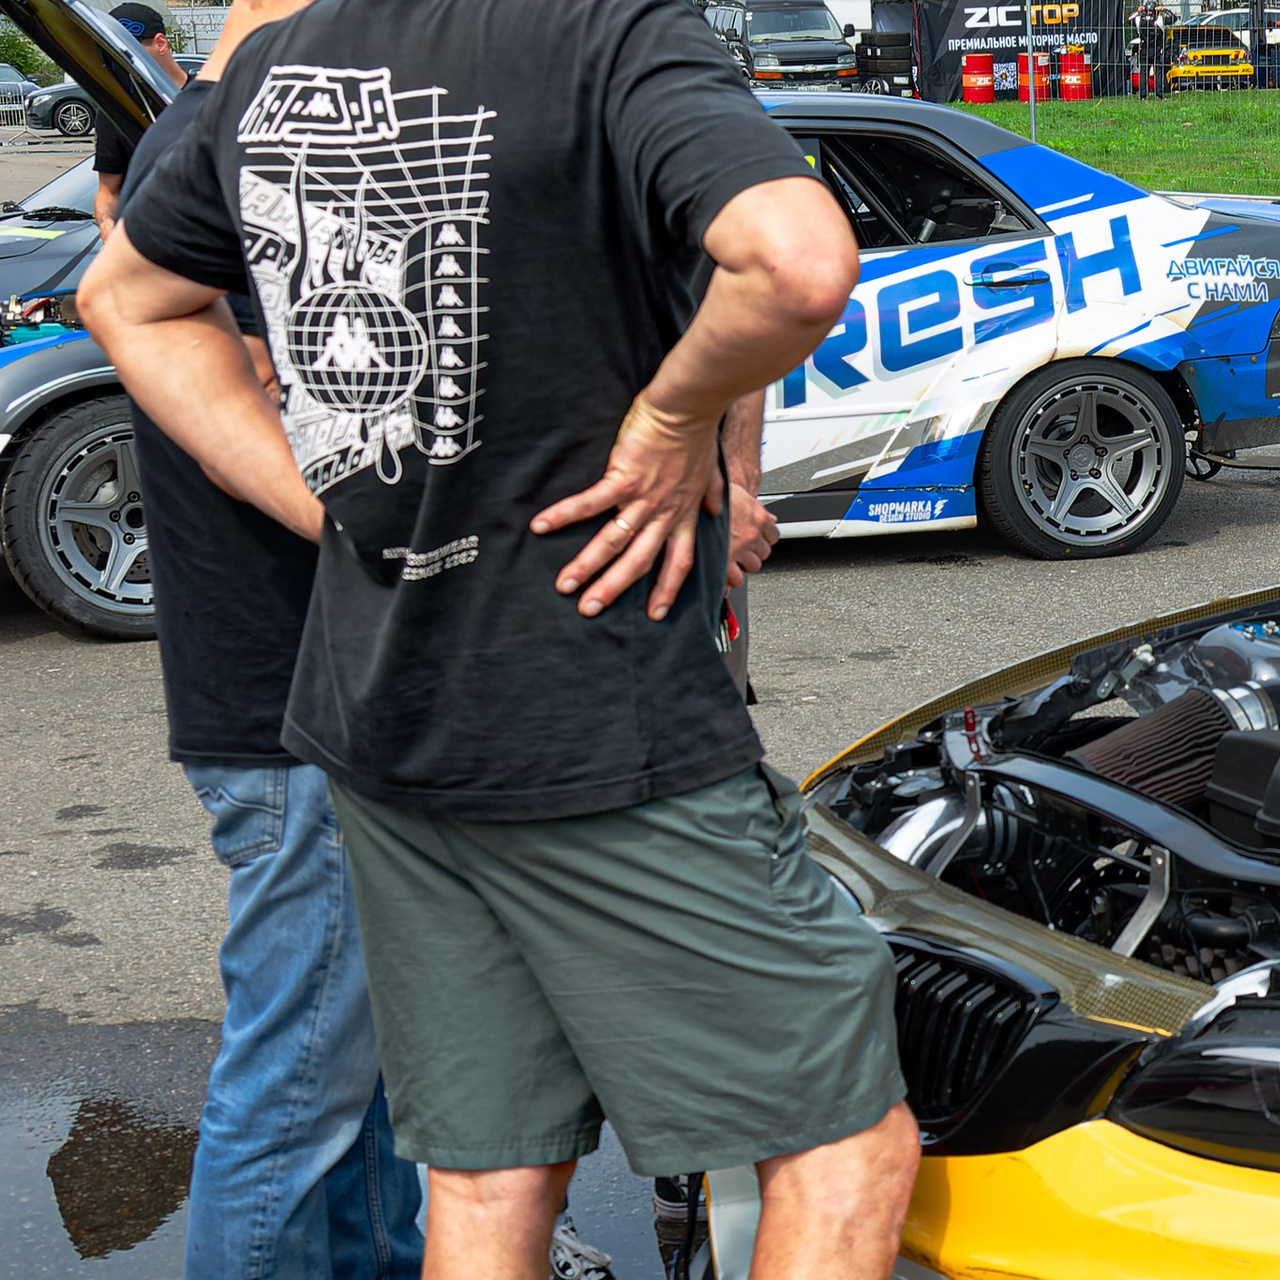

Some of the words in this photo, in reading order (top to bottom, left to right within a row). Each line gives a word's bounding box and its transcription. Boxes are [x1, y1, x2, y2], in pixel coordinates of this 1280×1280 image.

[964, 5, 1022, 28] ZIC
[1024, 3, 1080, 25] TOP
[948, 35, 1017, 51] ПРЕМИАЛЬНОЕ
[1066, 32, 1098, 45] МАСЛО
[1204, 281, 1269, 302] НАМИ
[868, 500, 932, 517] SHOPMARKA
[905, 511, 932, 521] STUDIO
